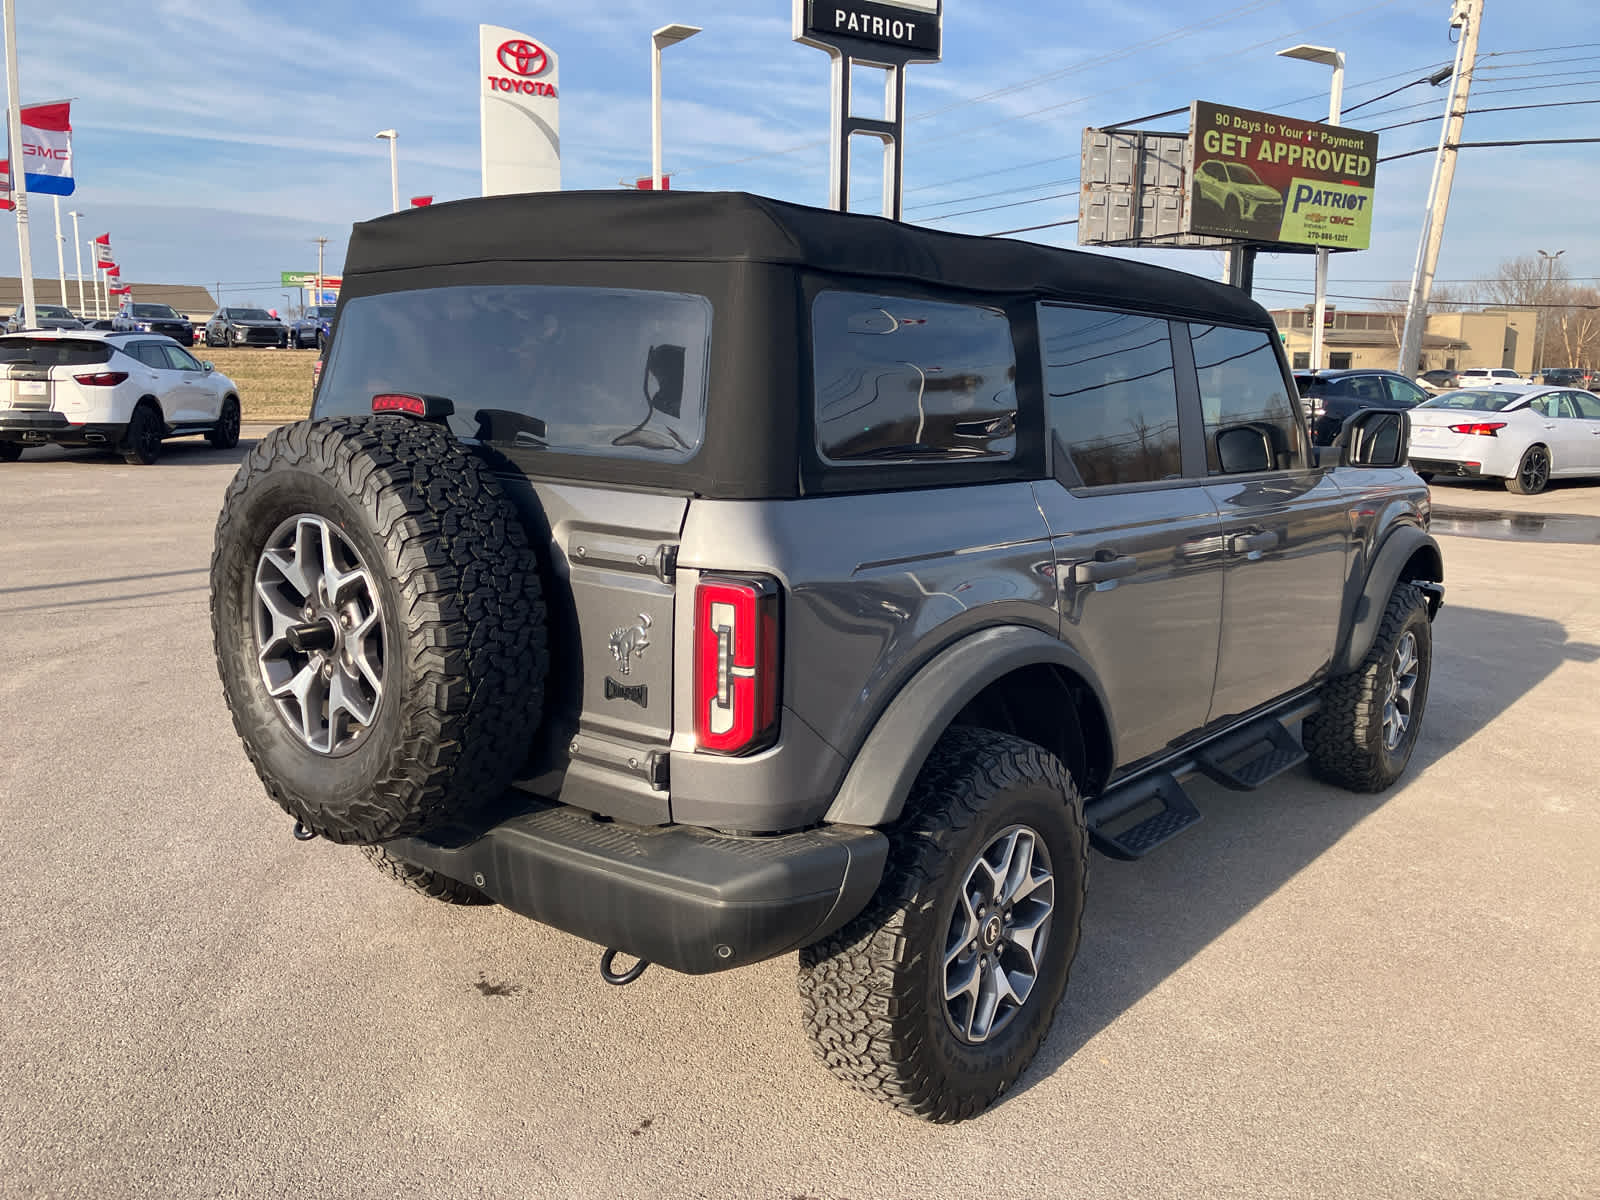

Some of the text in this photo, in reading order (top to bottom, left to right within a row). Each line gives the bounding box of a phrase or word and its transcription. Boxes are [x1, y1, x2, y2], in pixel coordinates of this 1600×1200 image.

[835, 9, 915, 41] PATRIOT
[488, 76, 556, 98] TOYOTA
[1215, 113, 1230, 127] 90
[1234, 116, 1261, 134] Days
[1265, 122, 1276, 135] to
[1280, 124, 1303, 140] Your
[1321, 132, 1364, 150] Payment
[22, 143, 69, 160] GMC
[1203, 130, 1371, 177] GET APPROVED
[1291, 184, 1368, 213] PATRIOT
